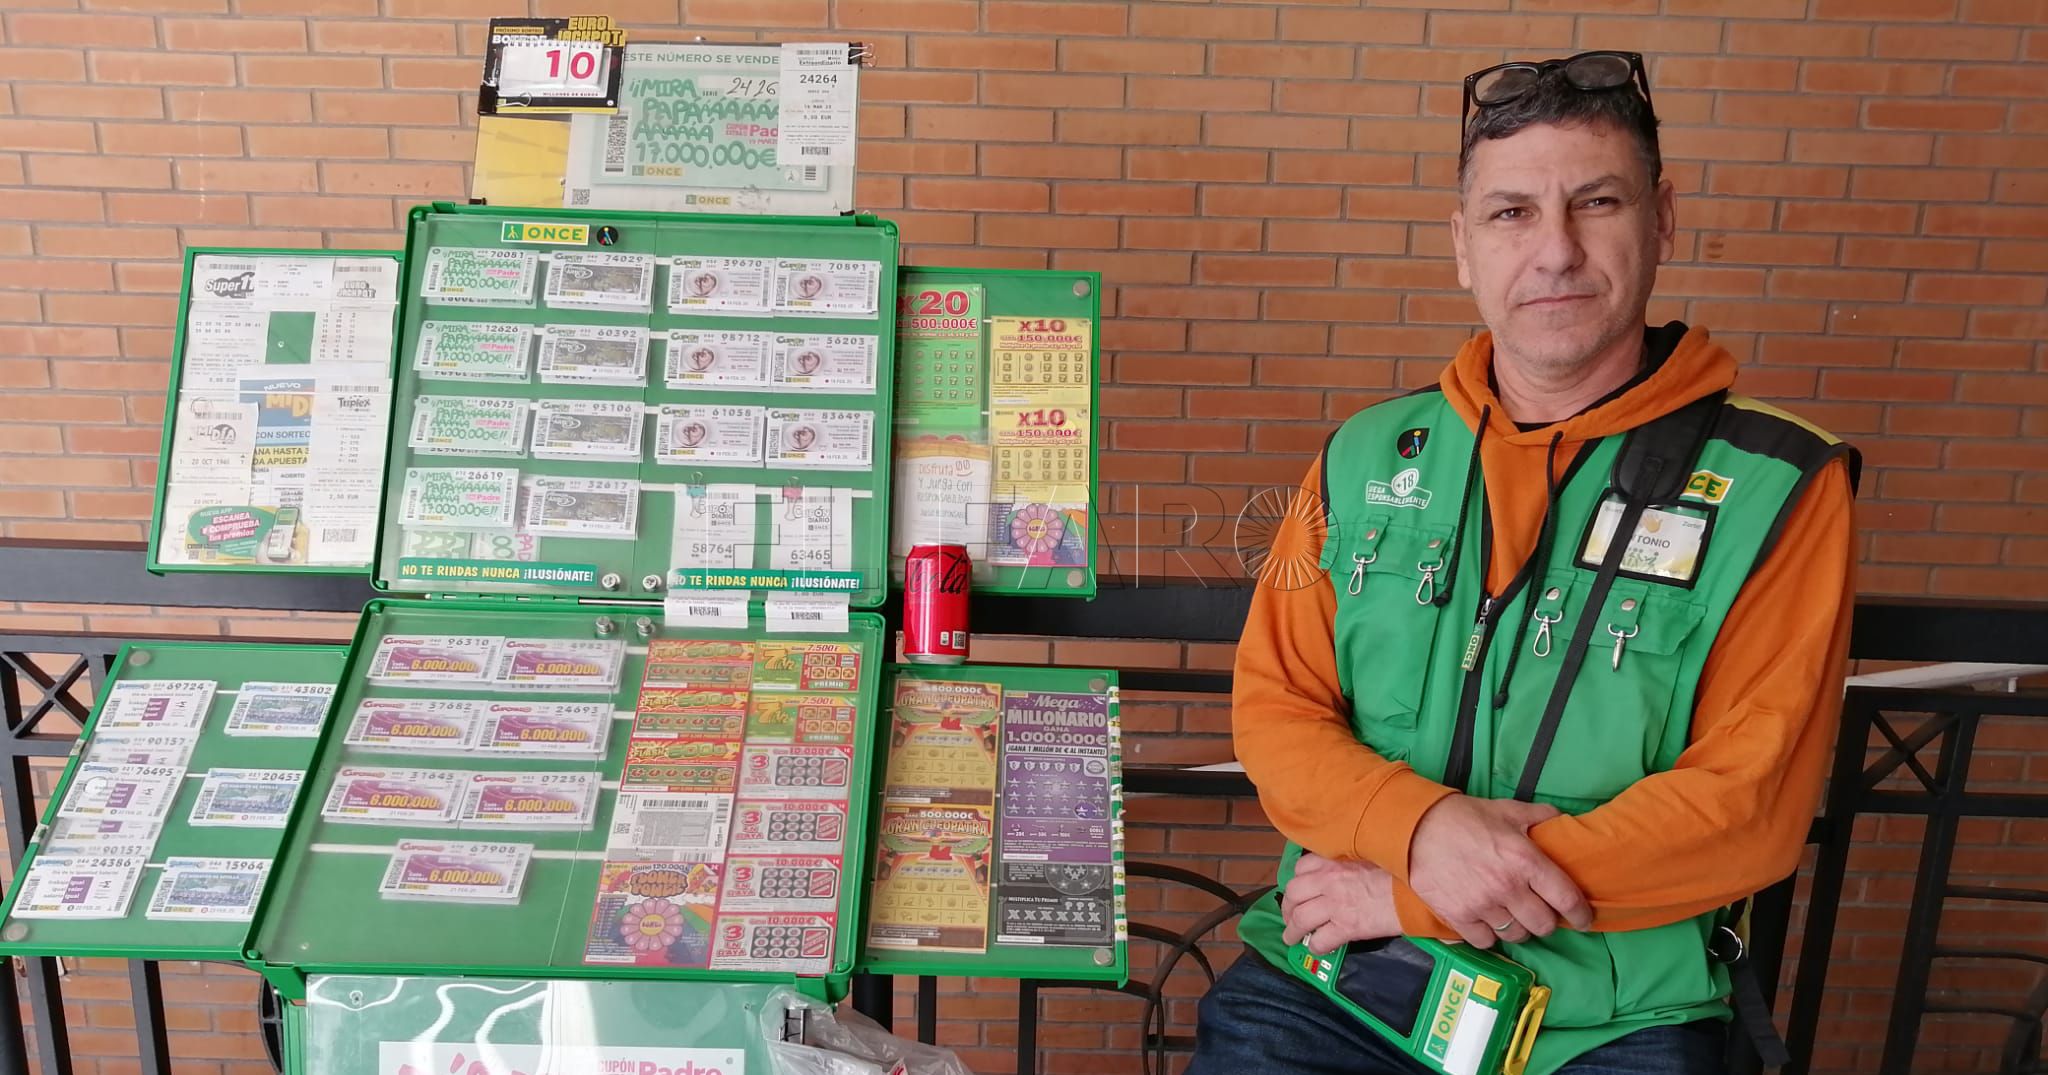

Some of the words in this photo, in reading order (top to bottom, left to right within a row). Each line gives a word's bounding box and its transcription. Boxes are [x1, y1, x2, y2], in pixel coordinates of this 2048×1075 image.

[568, 16, 609, 31] EURO
[558, 30, 622, 46] JACKPOT
[624, 53, 651, 62] ESTE
[657, 52, 712, 63] NÚMERO
[716, 54, 732, 63] SE
[735, 55, 779, 64] VENDE
[546, 50, 595, 79] 10
[800, 74, 838, 84] 24264
[749, 122, 779, 137] Pad
[646, 167, 681, 176] ONCE
[699, 196, 730, 205] ONCE
[528, 227, 583, 241] ONCE
[605, 254, 644, 263] 74029
[723, 259, 762, 267] 39670
[897, 289, 970, 316] x20
[486, 324, 519, 333] 12626
[911, 318, 977, 330] 500.000€
[1018, 319, 1067, 333] x10
[597, 328, 637, 338] 60392
[263, 382, 301, 391] NUEVO
[479, 399, 515, 409] 09675
[592, 403, 632, 412] 95106
[1018, 408, 1067, 427] x10
[273, 447, 303, 455] HASTA
[267, 457, 308, 465] APUESTA
[468, 471, 504, 481] 26619
[1396, 474, 1414, 491] +18
[1688, 475, 1722, 497] CE
[213, 512, 251, 524] ESCANEA
[209, 520, 260, 534] COMPRUEBA
[1633, 534, 1671, 549] TONIO
[692, 543, 733, 554] 58764
[790, 550, 831, 560] 63465
[402, 565, 417, 575] NO
[421, 565, 433, 575] TE
[437, 565, 478, 577] RINDAS
[482, 567, 520, 578] NUNCA
[524, 567, 593, 582] ¡ILUSIÓNATE!
[670, 574, 685, 585] NO
[690, 575, 702, 586] TE
[706, 575, 747, 587] RINDAS
[750, 576, 788, 587] NUNCA
[791, 576, 860, 589] ¡ILUSIÓNATE!
[448, 638, 489, 647] 96310
[1464, 636, 1478, 666] ONCE
[166, 682, 205, 690] 69724
[294, 686, 332, 695] 43802
[1035, 695, 1080, 711] Mega
[555, 705, 598, 714] 24693
[1006, 709, 1106, 728] MILLONARIO
[147, 737, 186, 746] 90157
[1007, 731, 1107, 745] 1.000.000€
[750, 755, 769, 769] 3
[135, 766, 174, 777] 76495
[262, 772, 301, 782] 20453
[541, 775, 586, 783] 07256
[742, 809, 763, 825] 3
[103, 846, 142, 855] 90157
[470, 845, 516, 854] 67908
[91, 858, 131, 868] 24386
[225, 860, 264, 871] 15964
[733, 867, 754, 882] 3
[724, 925, 745, 941] 3
[1438, 978, 1467, 1035] ONCE
